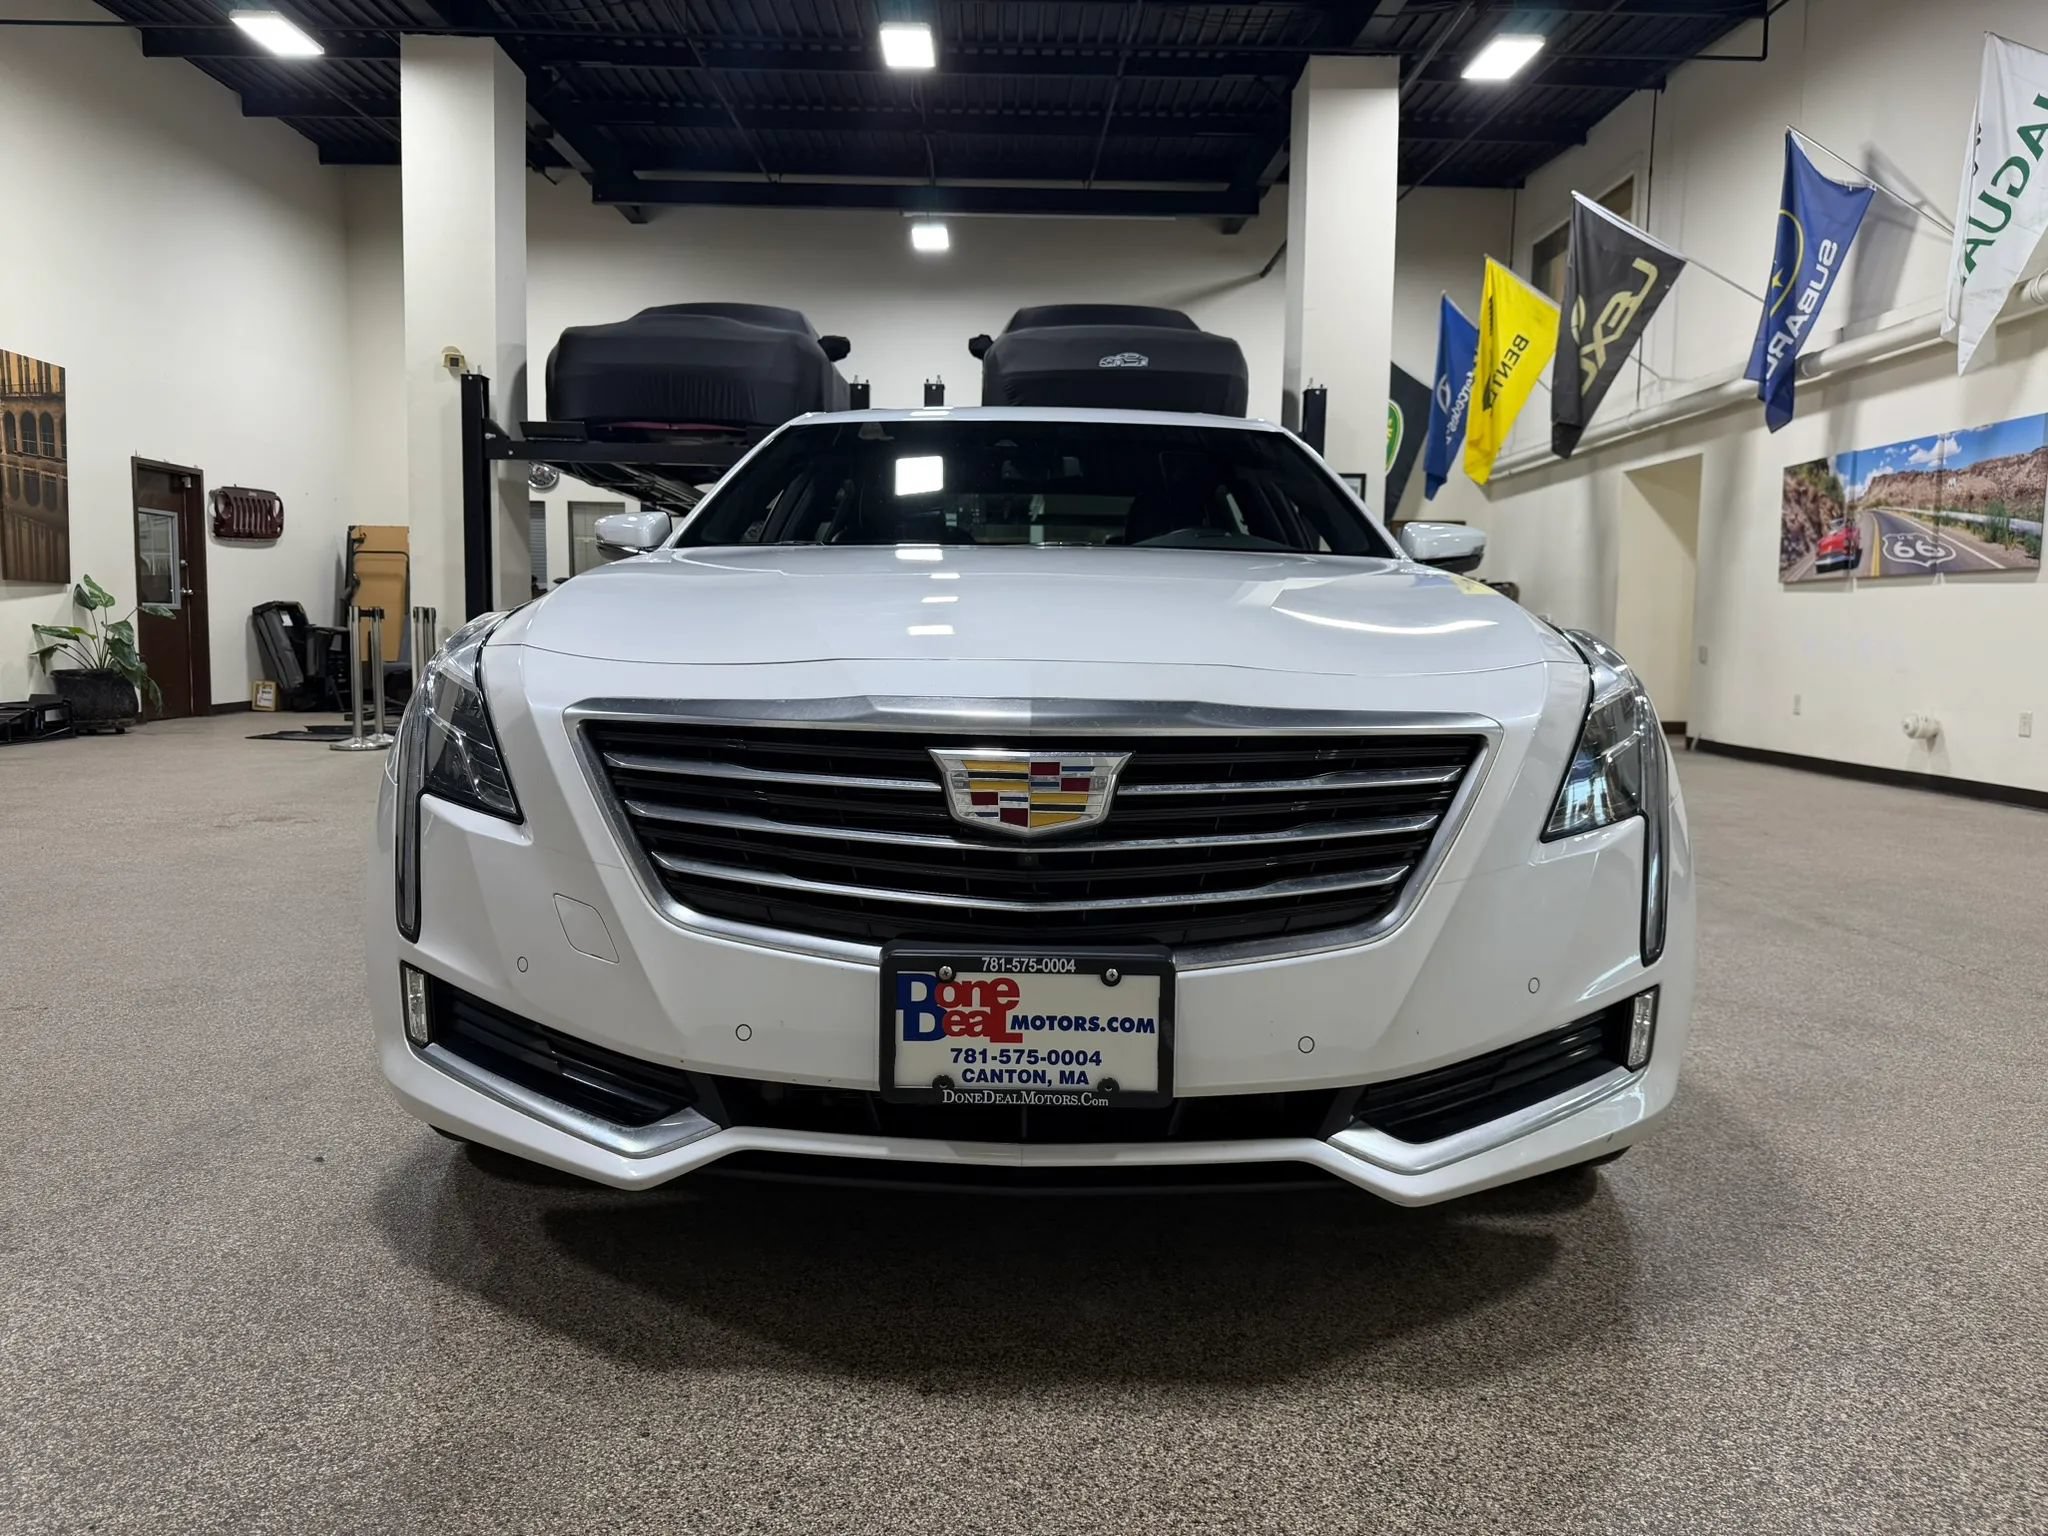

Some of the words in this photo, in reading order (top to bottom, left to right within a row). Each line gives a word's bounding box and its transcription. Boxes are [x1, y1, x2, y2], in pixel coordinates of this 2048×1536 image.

[1893, 540, 1946, 558] 66
[981, 957, 1076, 973] 781-575-0004
[1010, 1015, 1155, 1034] MOTORS.COM
[951, 1048, 1102, 1066] 781-575-0004
[962, 1068, 1052, 1087] CANTON,
[1059, 1070, 1089, 1085] MA
